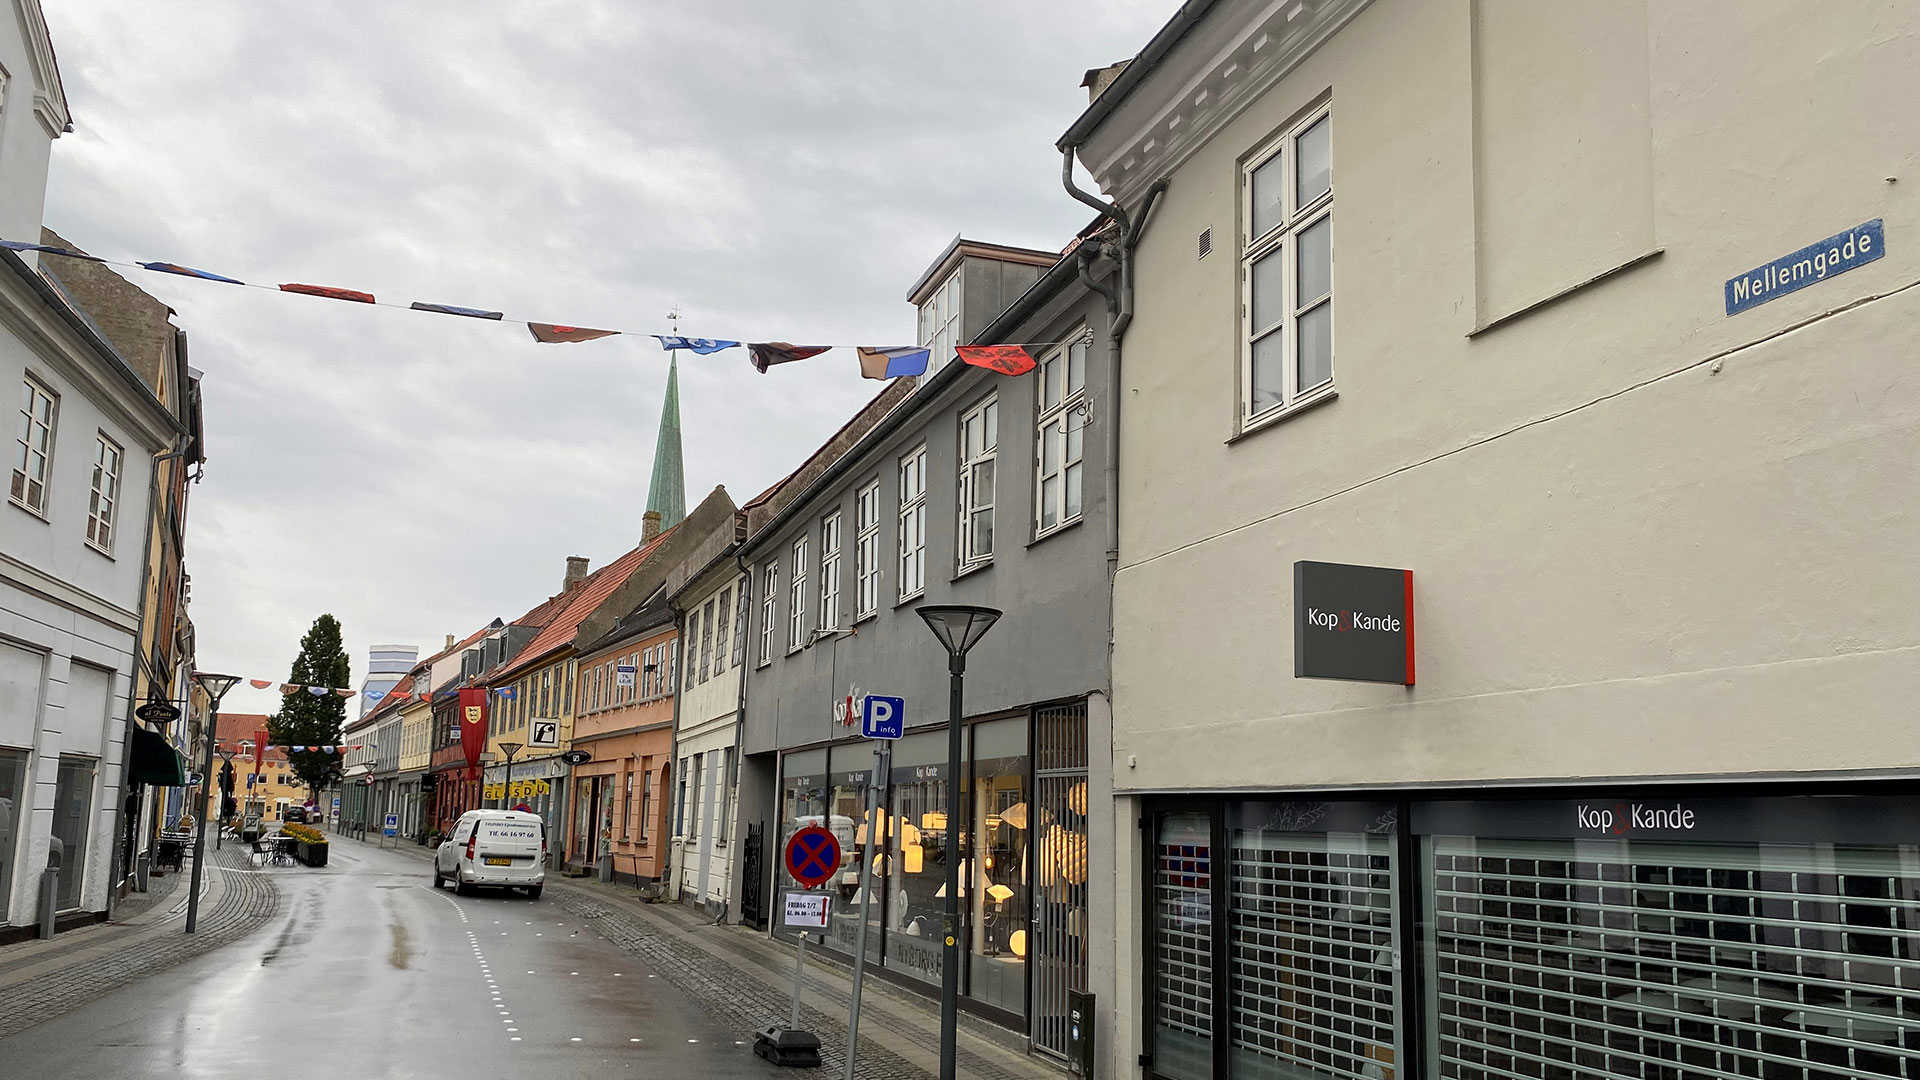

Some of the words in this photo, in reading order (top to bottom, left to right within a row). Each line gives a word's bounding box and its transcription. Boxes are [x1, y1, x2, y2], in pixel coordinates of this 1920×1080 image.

[1733, 232, 1871, 304] Mellemgade
[1308, 607, 1338, 630] Kop
[1353, 611, 1401, 632] Kande
[870, 700, 893, 732] P
[880, 726, 896, 734] info
[485, 783, 545, 799] GLSDU
[1577, 804, 1613, 834] Kop
[1631, 803, 1695, 829] Kande
